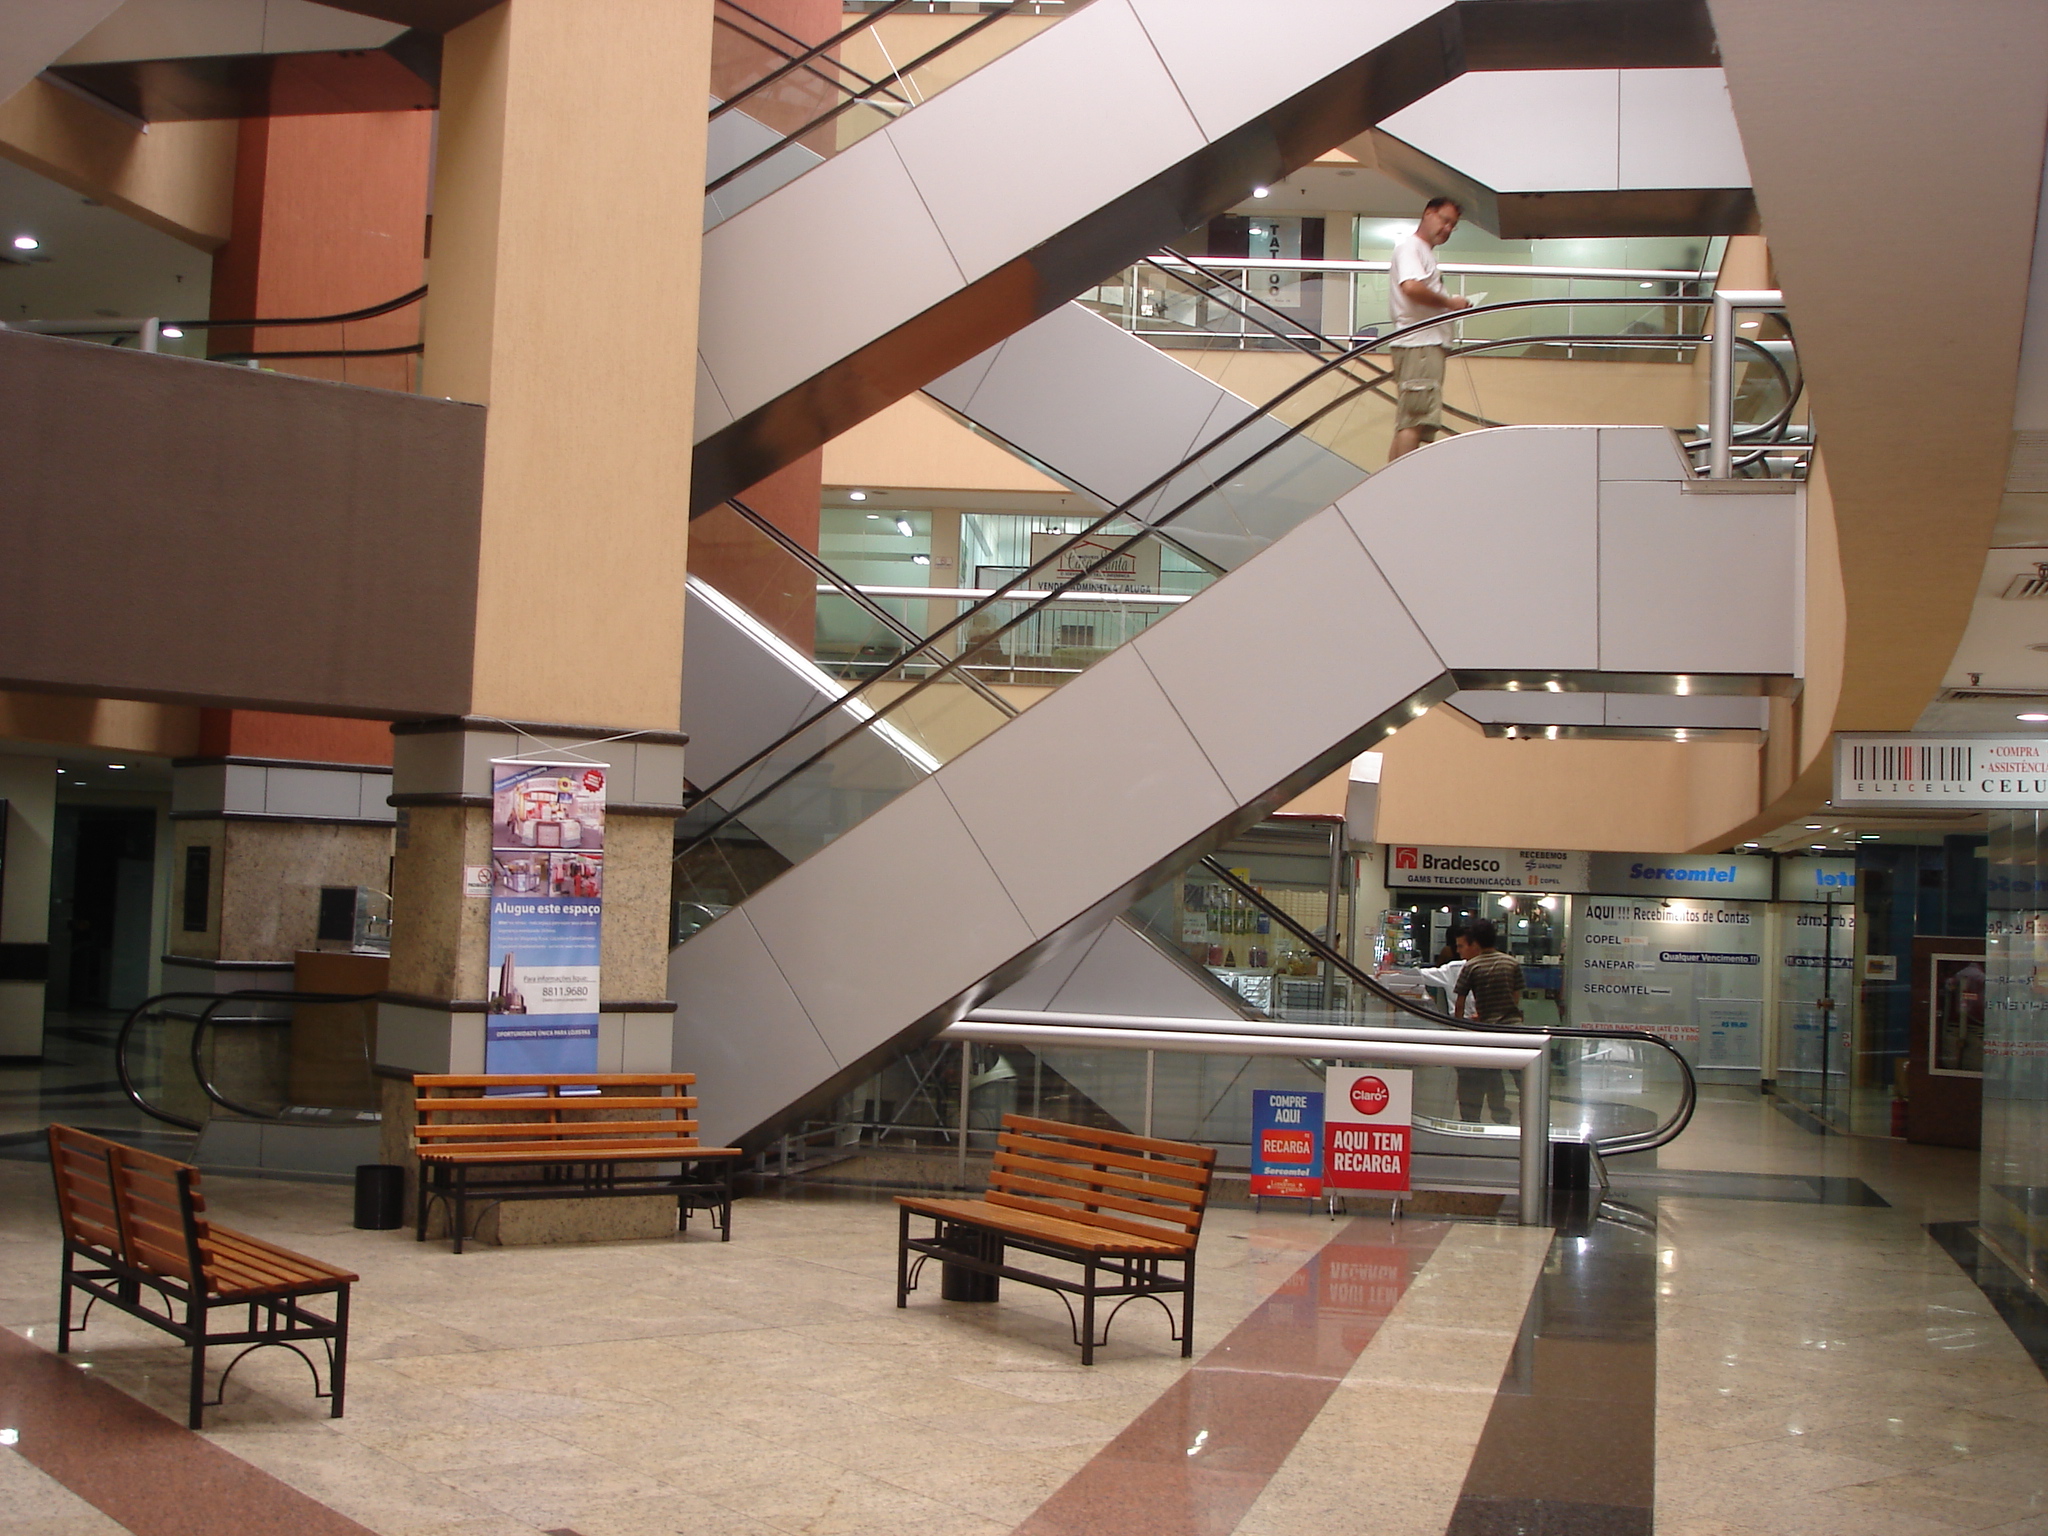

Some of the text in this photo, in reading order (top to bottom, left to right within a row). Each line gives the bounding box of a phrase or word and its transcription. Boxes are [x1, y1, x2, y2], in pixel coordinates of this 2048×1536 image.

[1269, 225, 1280, 297] TATOO
[1125, 584, 1151, 594] ALUGA
[1996, 746, 2039, 757] COMPRA
[1857, 783, 1966, 792] ELICELL
[1981, 779, 2048, 793] CELU
[1520, 851, 1568, 860] RECEBEMOS
[1422, 854, 1500, 872] Bradesco
[1630, 863, 1736, 883] Sercomtel
[1407, 875, 1521, 886] GAMS TELECOMUNICAÇÕES
[495, 902, 600, 916] Alugue este espaço
[1586, 906, 1750, 924] AQUI !!! Recebimtos de Contas
[1585, 934, 1621, 945] COPEL
[1584, 959, 1635, 970] SANEPAR
[1662, 952, 1700, 963] Qualquer
[1701, 953, 1749, 964] Vencimento
[542, 986, 588, 996] 8811.9680
[1584, 984, 1650, 995] SERCOMTEL
[1352, 1088, 1385, 1101] Claro
[1270, 1095, 1307, 1108] COMPRE
[1275, 1109, 1300, 1123] AQUI
[1264, 1139, 1311, 1154] RECARGA
[1334, 1130, 1403, 1151] AQUI TEM
[1334, 1152, 1401, 1173] RECARGA
[1264, 1167, 1310, 1177] Sercomtel
